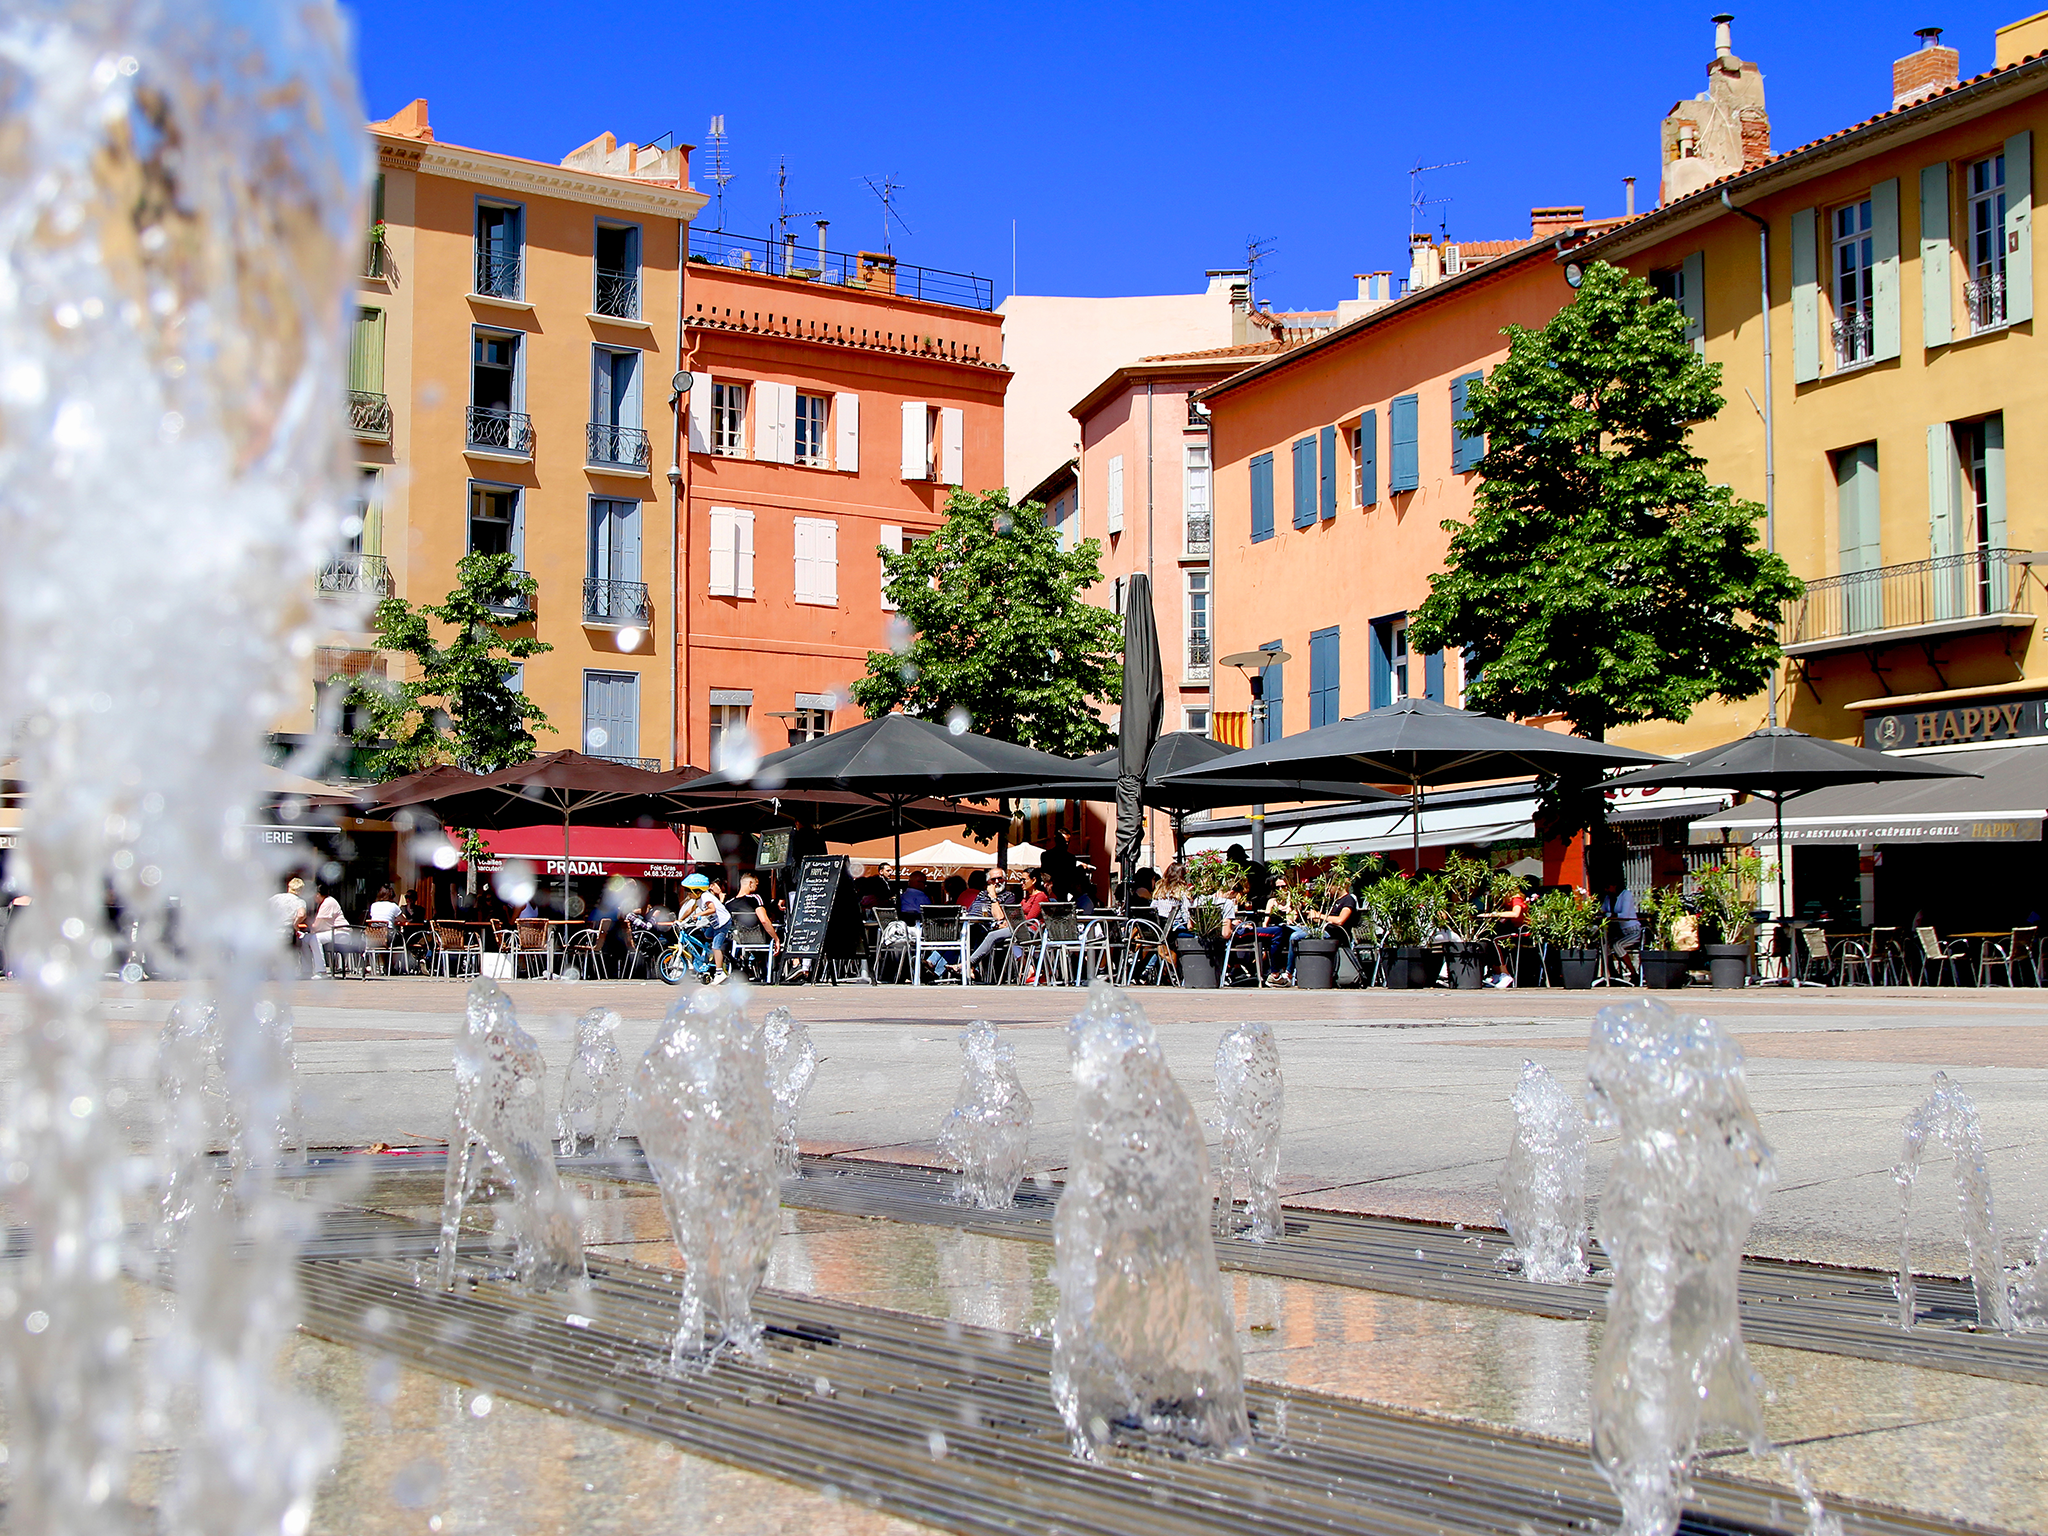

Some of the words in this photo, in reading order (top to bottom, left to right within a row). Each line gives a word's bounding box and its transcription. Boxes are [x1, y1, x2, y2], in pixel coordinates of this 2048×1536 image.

[1914, 703, 2023, 744] HAPPY
[250, 831, 294, 844] HERIE
[1706, 830, 1744, 843] HAPY
[1752, 830, 1800, 841] BRASSRIE
[1806, 828, 1868, 839] RESTAURANT
[1874, 826, 1922, 837] CRÊPERIE
[1929, 826, 1960, 836] GRILL
[1971, 822, 2019, 838] HAPPY
[547, 860, 608, 875] PRADAL
